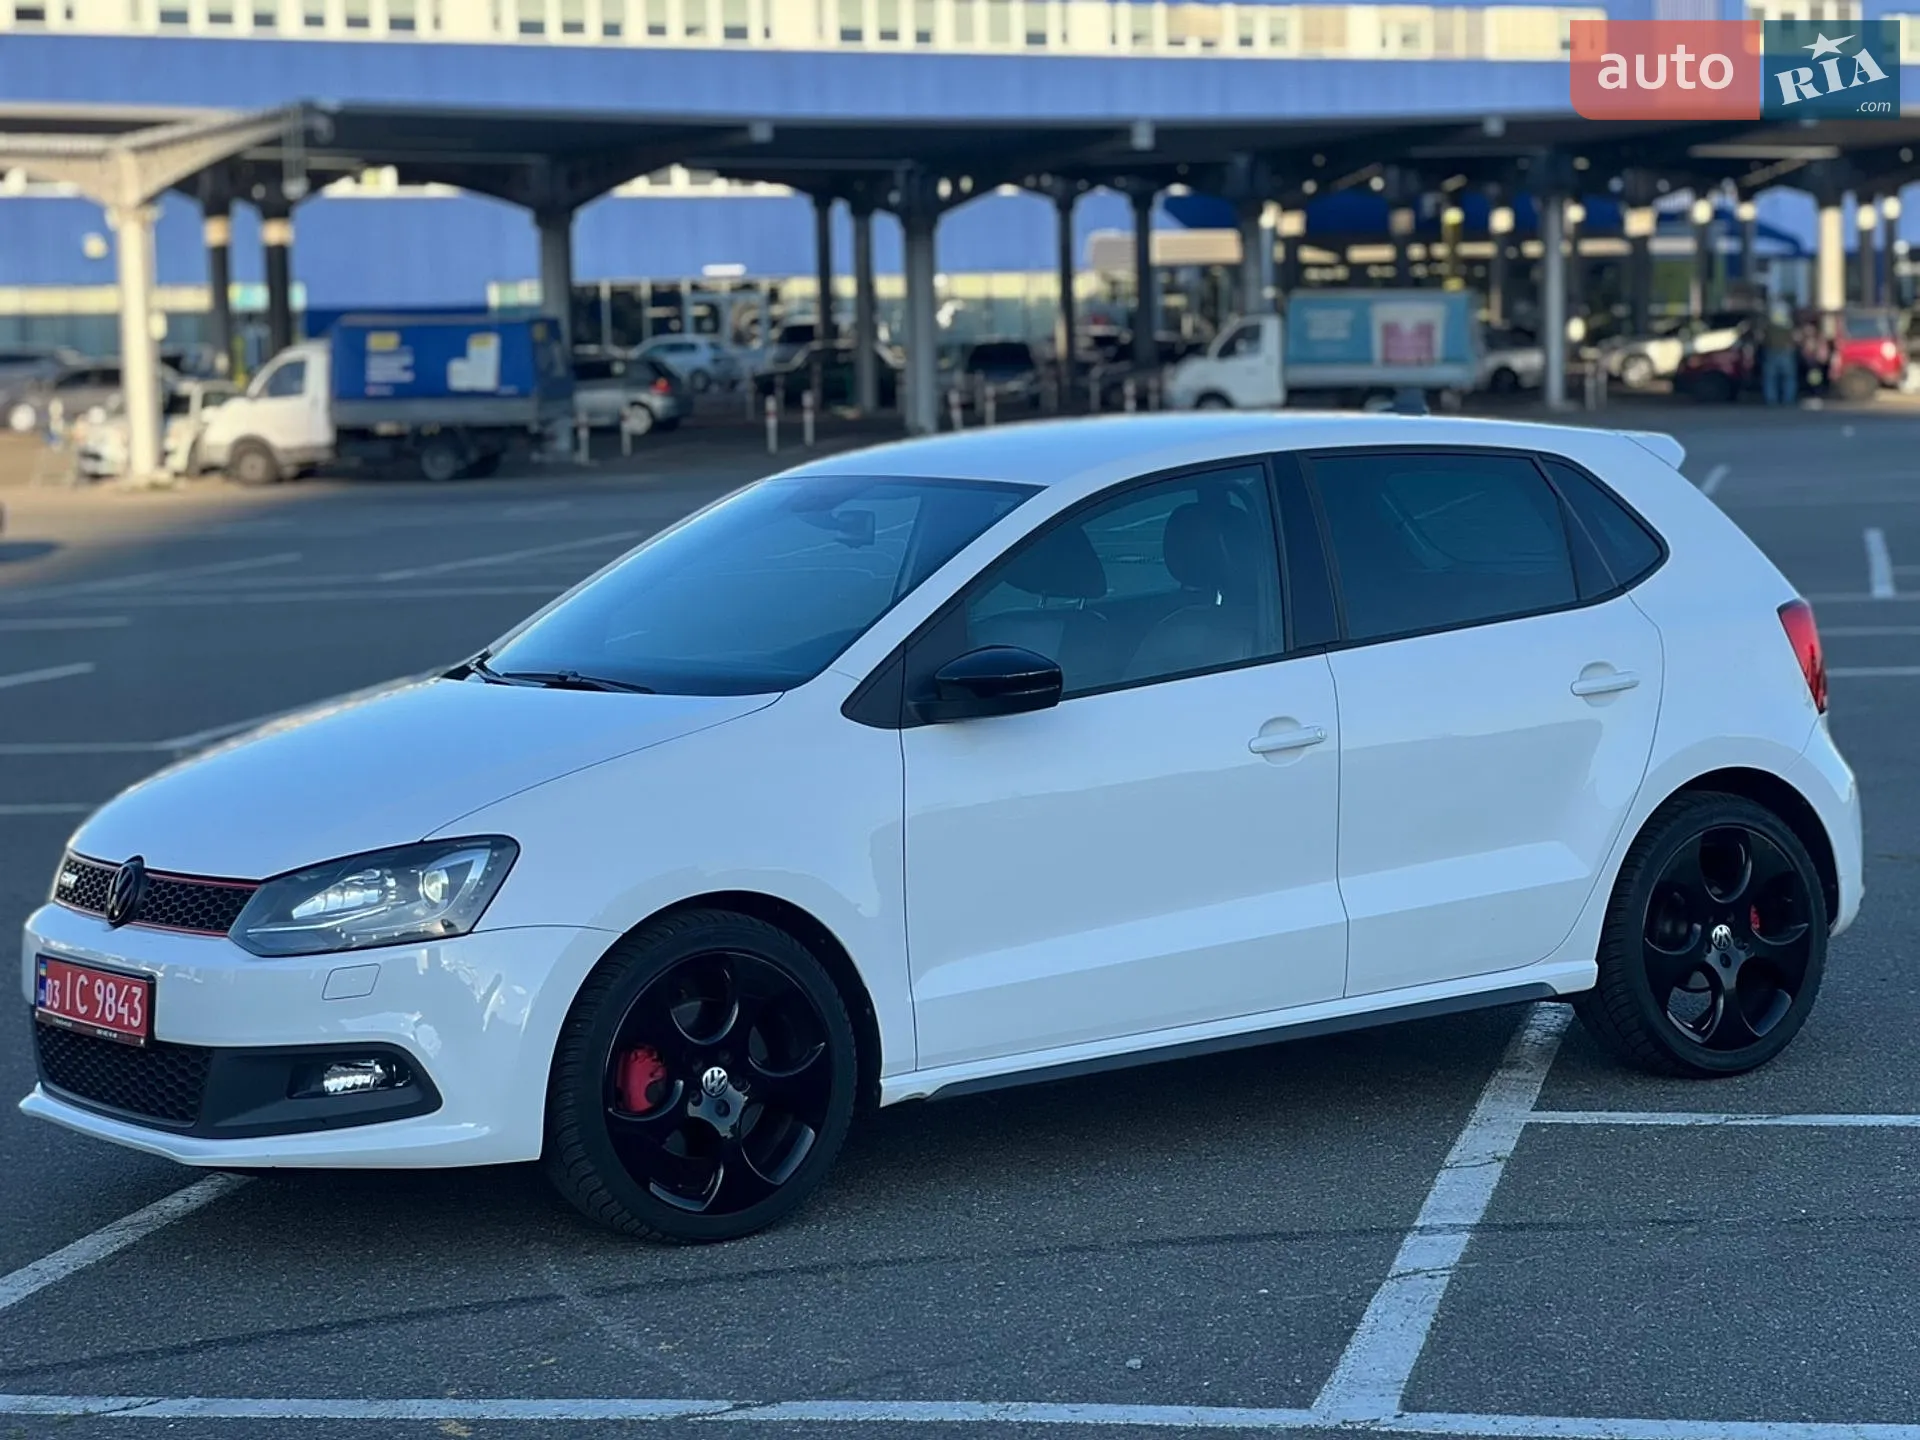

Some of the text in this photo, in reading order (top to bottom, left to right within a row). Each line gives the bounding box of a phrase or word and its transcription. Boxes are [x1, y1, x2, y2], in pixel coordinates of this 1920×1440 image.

[46, 972, 142, 1027] 03 IC 9843
